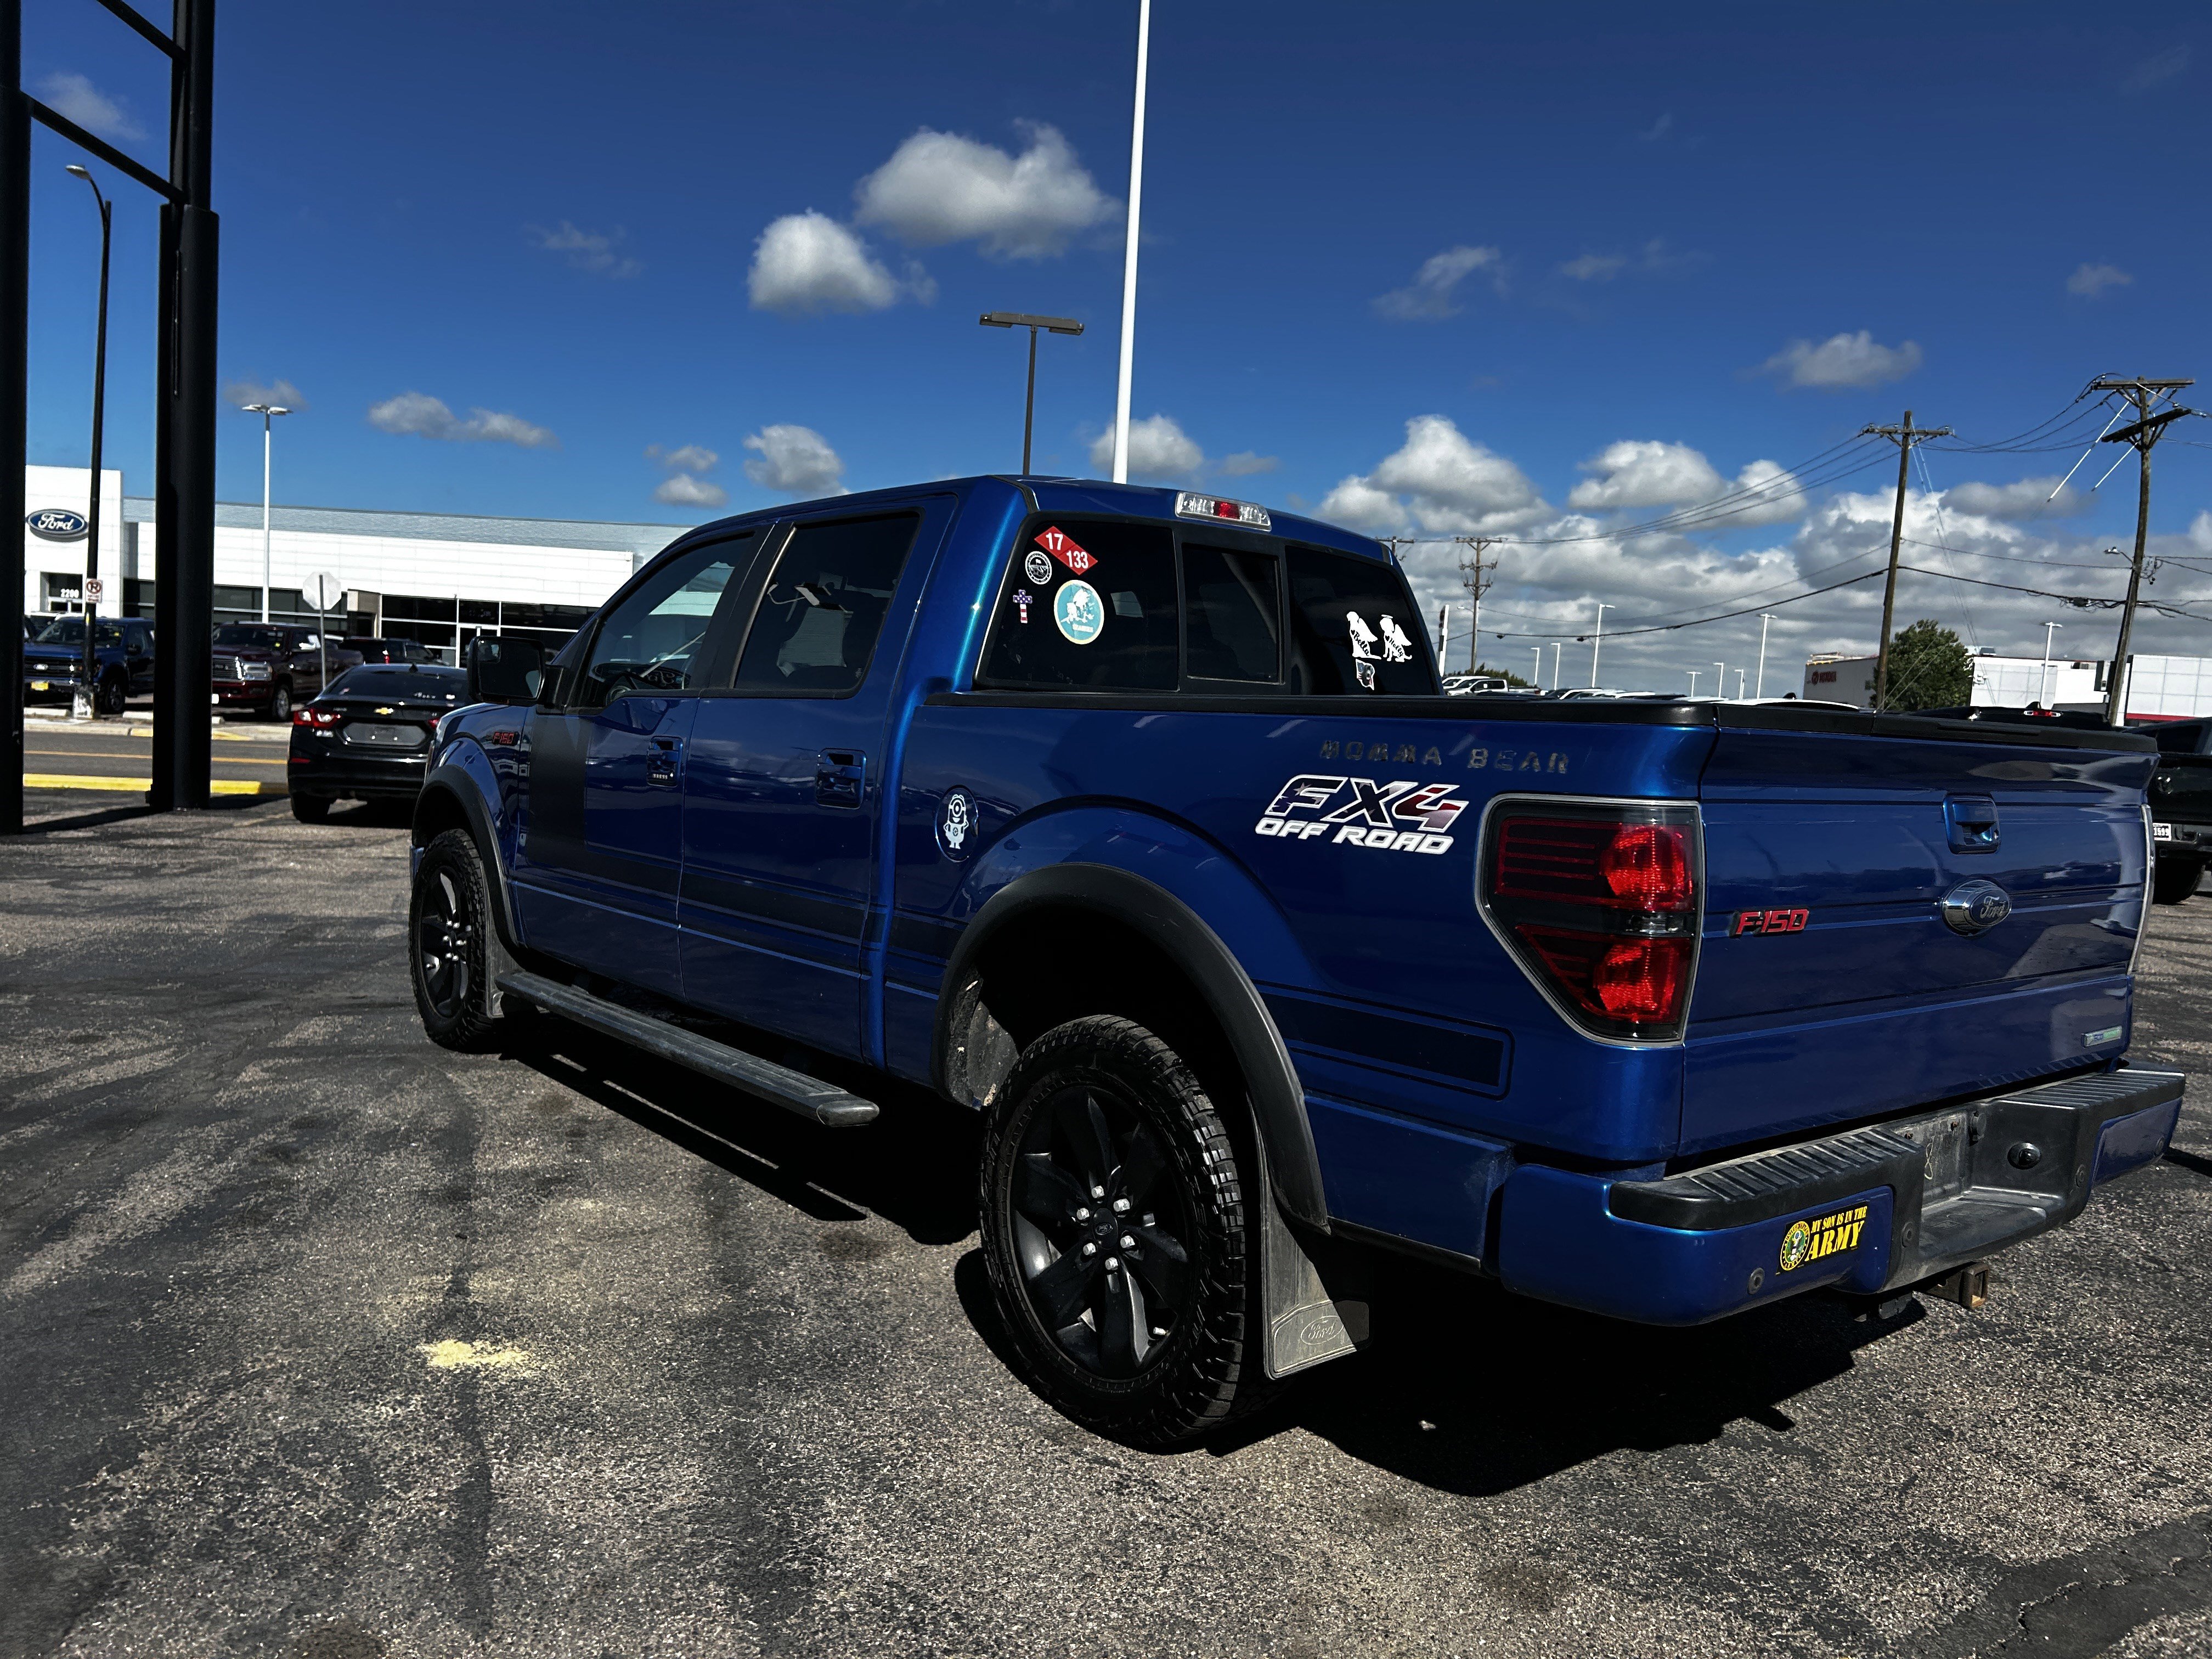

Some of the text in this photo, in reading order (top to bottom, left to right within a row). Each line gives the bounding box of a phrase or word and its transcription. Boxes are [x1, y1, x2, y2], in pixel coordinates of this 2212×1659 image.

[38, 513, 74, 531] Ford
[1045, 532, 1063, 550] 17
[1066, 550, 1089, 569] 133
[1353, 631, 1369, 656] Bella
[1467, 748, 1569, 774] BEAR
[1264, 774, 1469, 833] FX4
[1255, 817, 1454, 855] OFF ROAD
[1979, 896, 2007, 919] Ford
[1735, 909, 1809, 935] F-150
[1811, 1206, 1867, 1233] MY SON IS IN THE
[1804, 1220, 1865, 1261] ARMY
[1308, 1319, 1335, 1339] Ford
